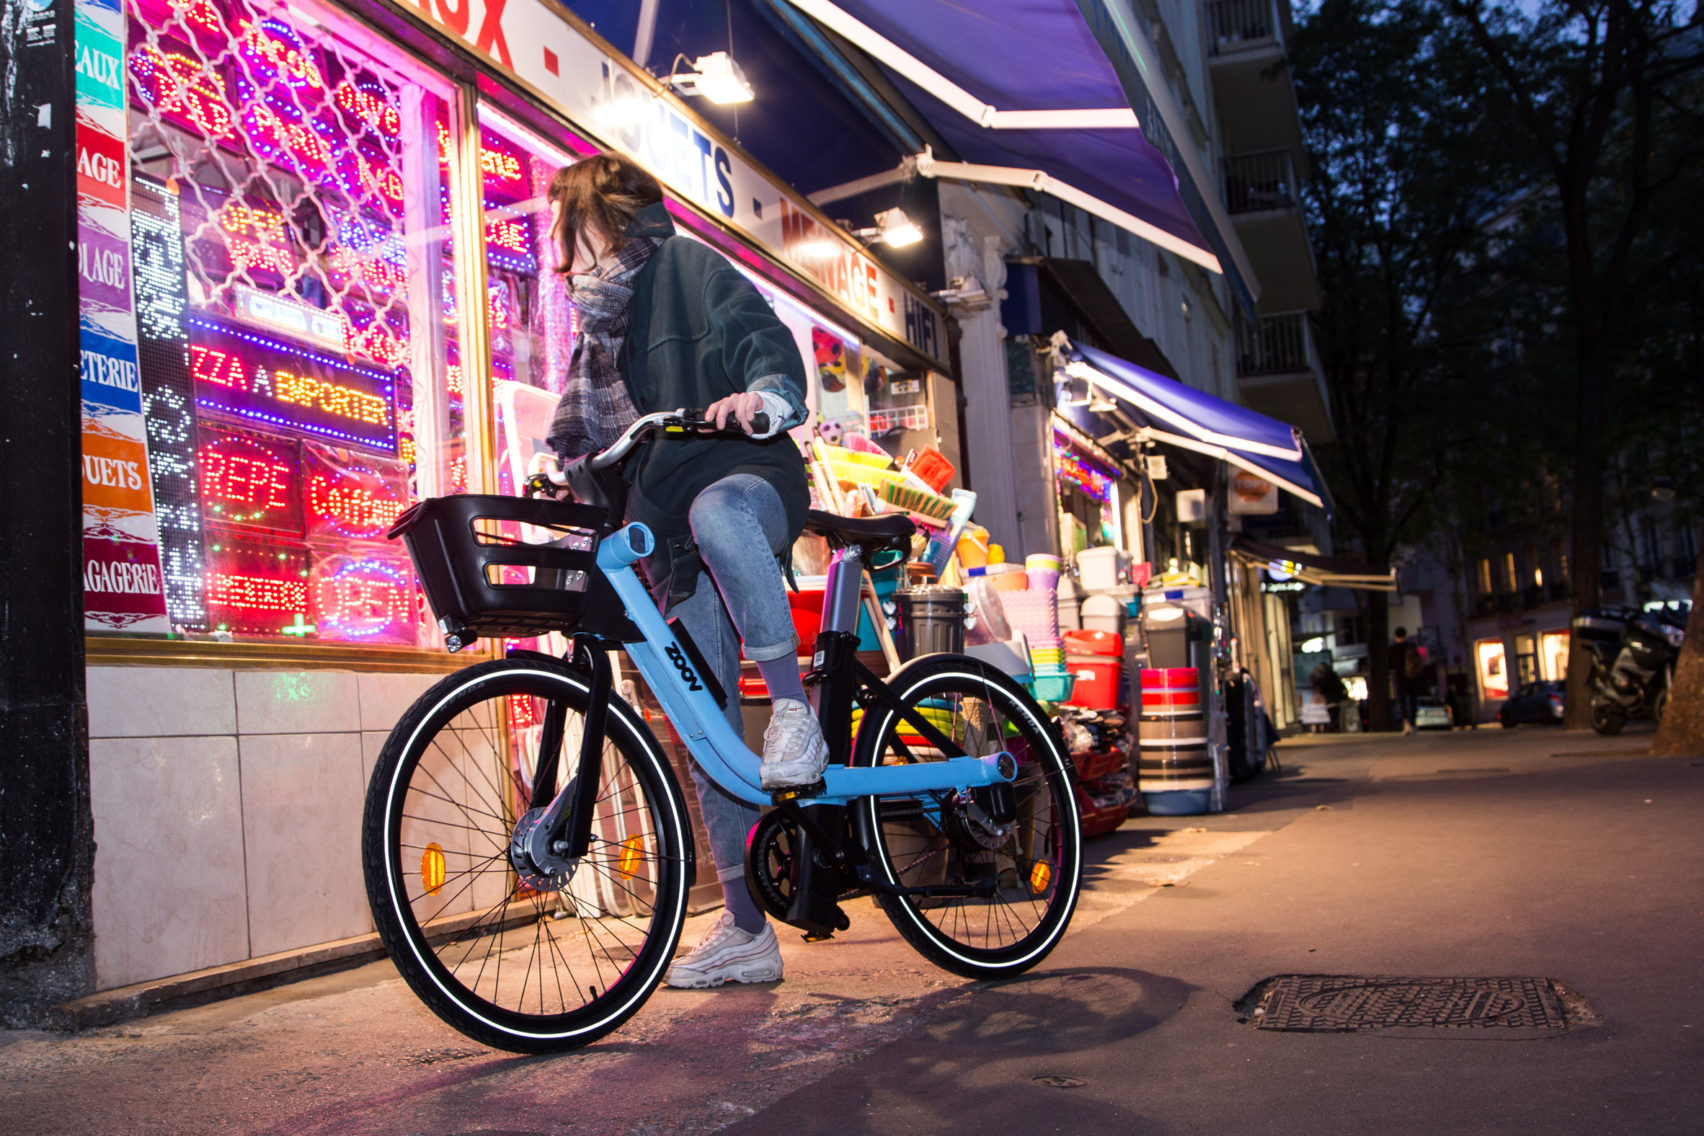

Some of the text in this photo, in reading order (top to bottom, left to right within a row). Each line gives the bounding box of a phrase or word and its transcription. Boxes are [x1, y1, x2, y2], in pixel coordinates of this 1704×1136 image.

[76, 147, 122, 190] AGE
[78, 242, 126, 290] LAGE
[251, 364, 274, 398] A
[82, 453, 143, 491] UETS
[198, 451, 291, 508] REPE
[316, 572, 410, 623] OPEN
[664, 641, 703, 692] ZOOV
